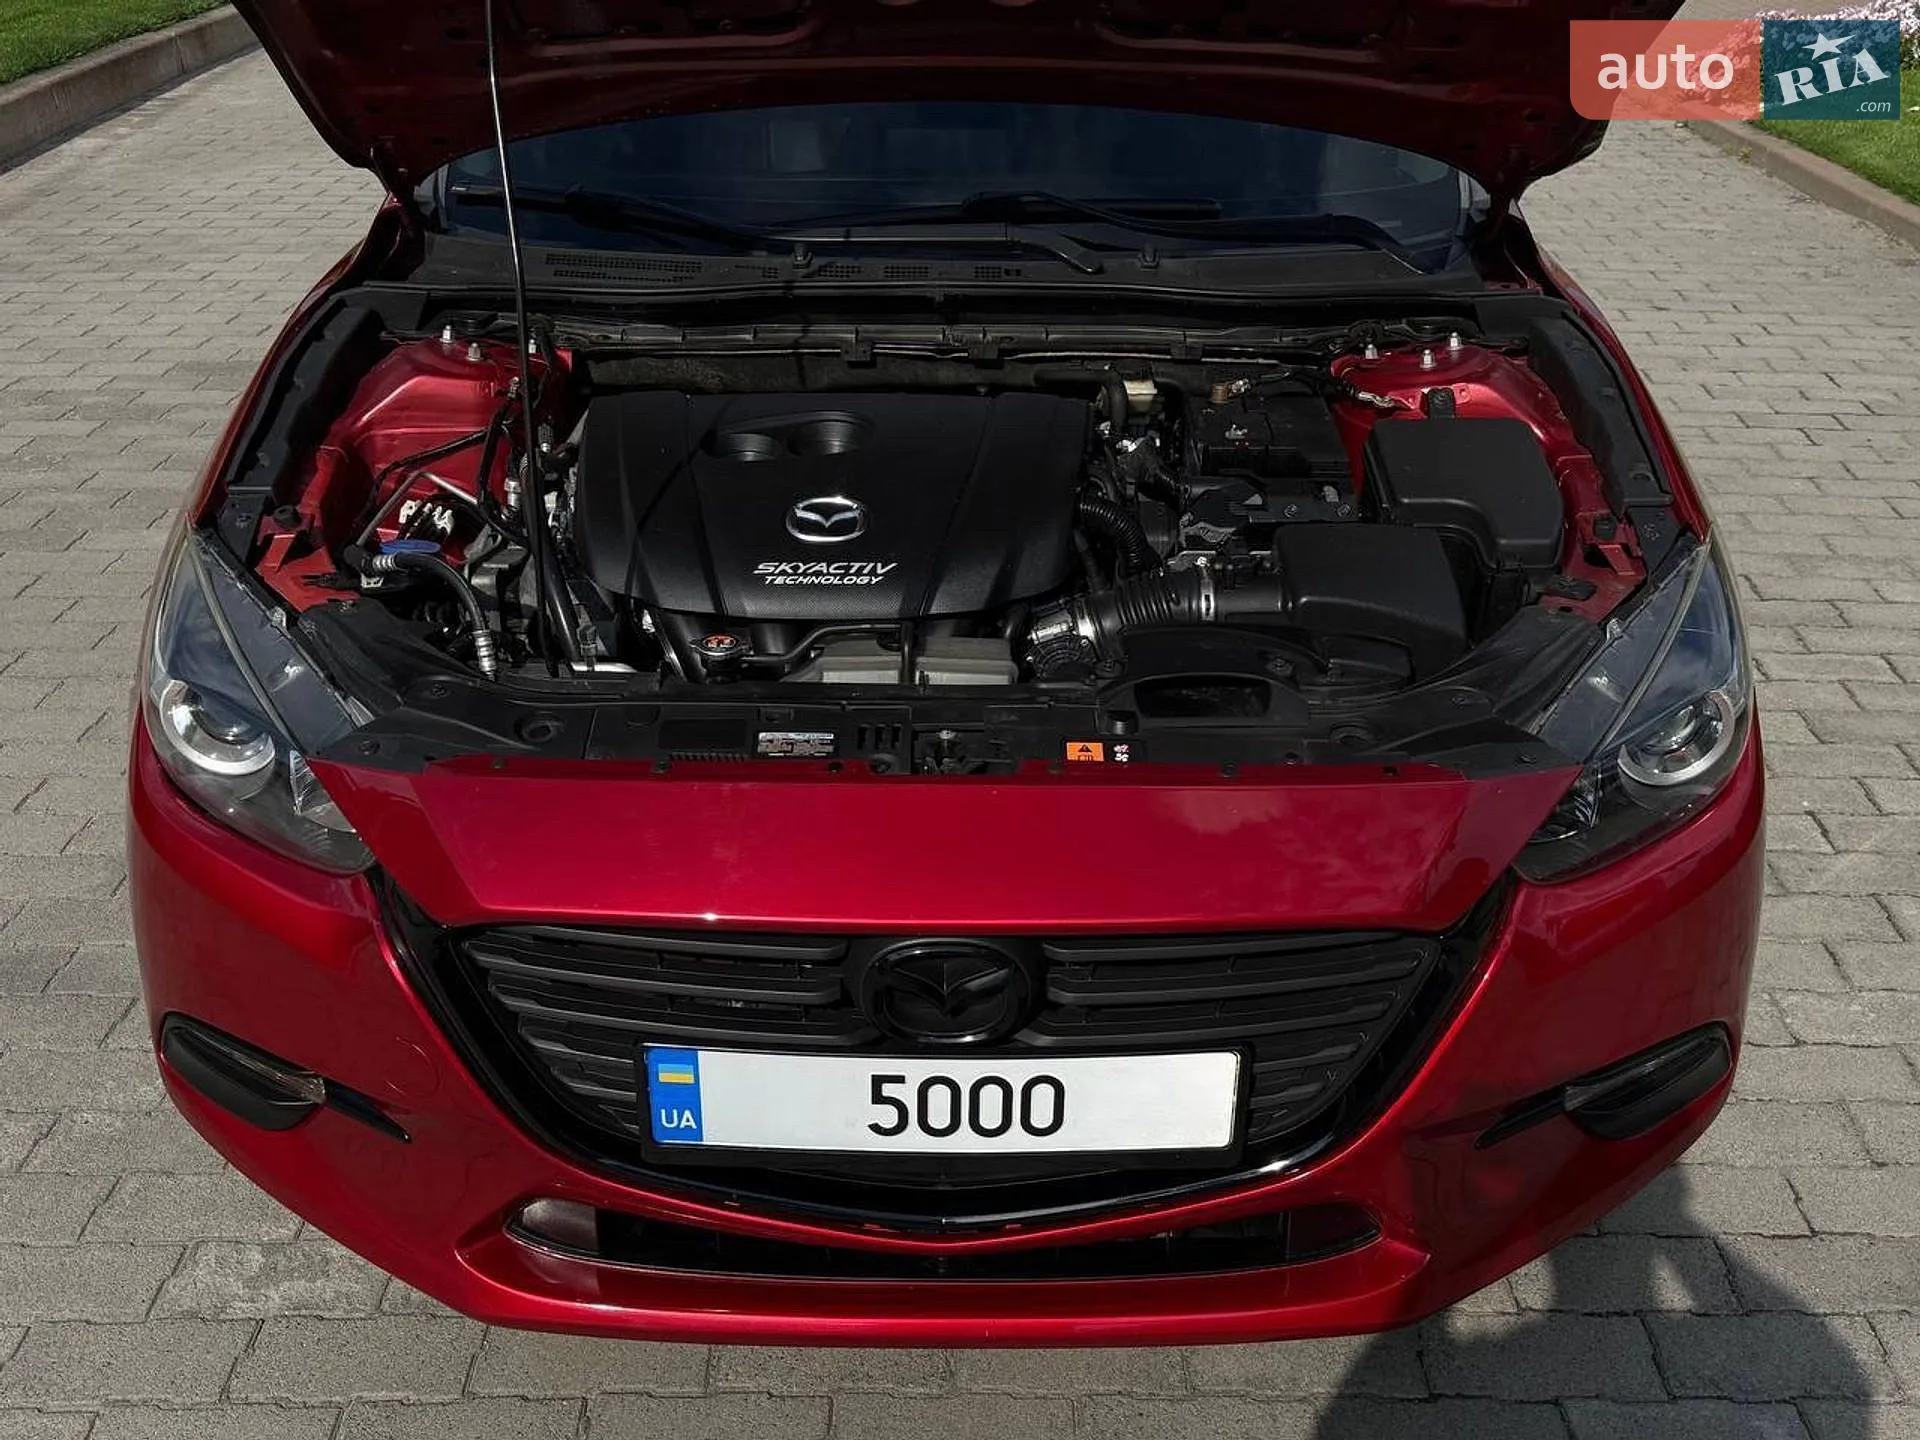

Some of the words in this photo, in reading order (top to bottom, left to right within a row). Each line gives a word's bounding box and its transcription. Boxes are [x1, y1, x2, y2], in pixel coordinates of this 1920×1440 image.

[752, 562, 899, 575] SKYACTIV
[764, 575, 884, 585] TECHNOLOGY
[867, 1074, 1066, 1138] 5000
[661, 1108, 697, 1129] UA
